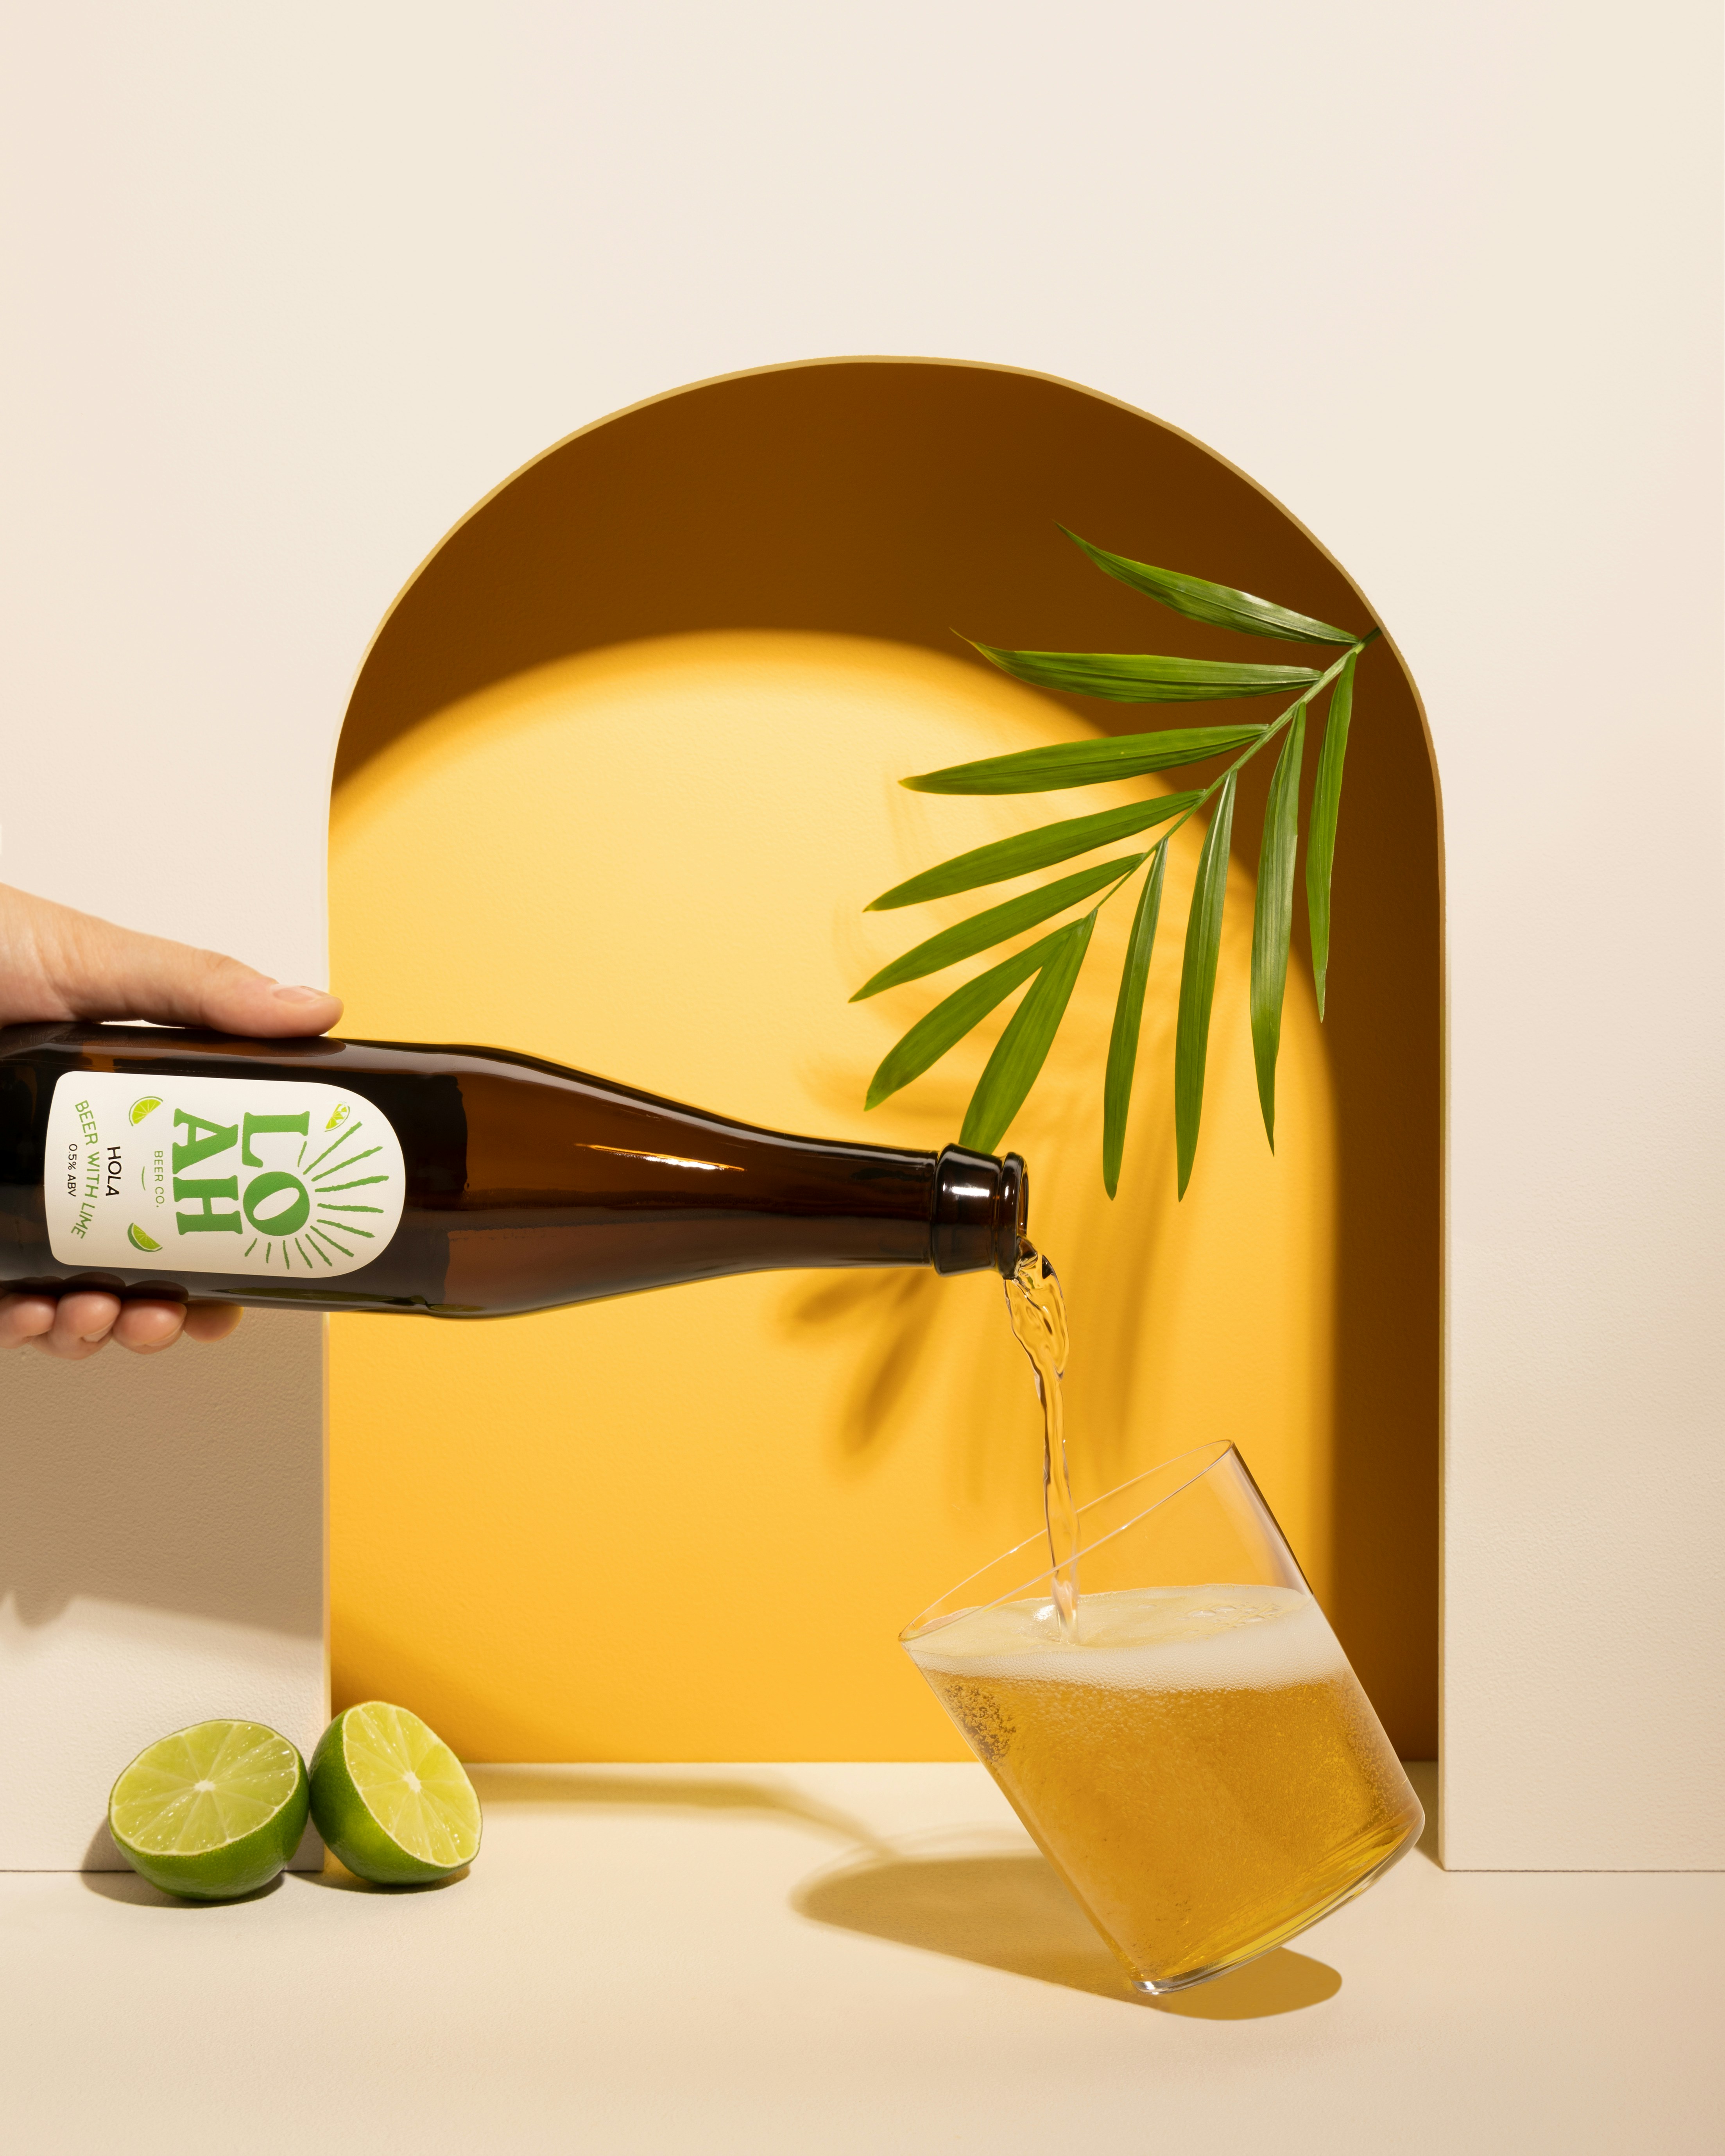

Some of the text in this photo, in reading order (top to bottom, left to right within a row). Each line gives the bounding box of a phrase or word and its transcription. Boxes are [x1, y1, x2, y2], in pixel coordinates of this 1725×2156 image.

[67, 1143, 77, 1197] 0.5% ABV
[71, 1100, 100, 1239] BEER WITH LIME
[106, 1146, 122, 1196] HOLA
[154, 1150, 165, 1208] BEER CO.
